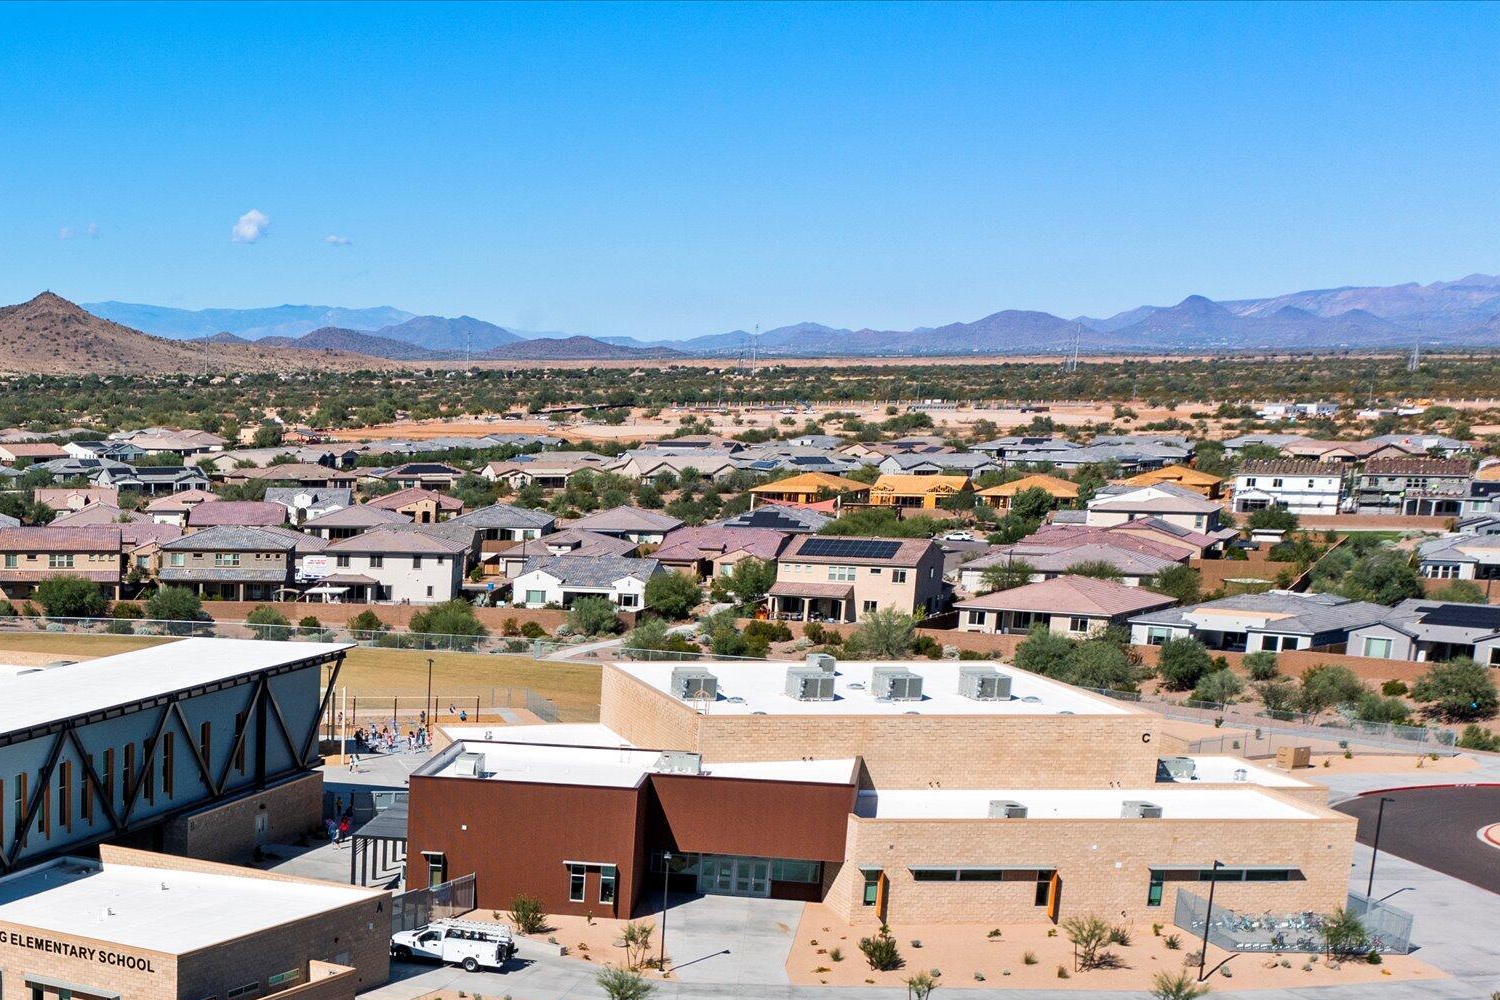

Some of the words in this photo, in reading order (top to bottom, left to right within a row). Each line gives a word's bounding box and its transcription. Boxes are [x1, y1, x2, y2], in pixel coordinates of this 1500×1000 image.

[1141, 732, 1151, 743] C
[376, 901, 383, 913] A
[10, 932, 96, 961] ELEMENTARY
[98, 950, 155, 973] SCHOOL
